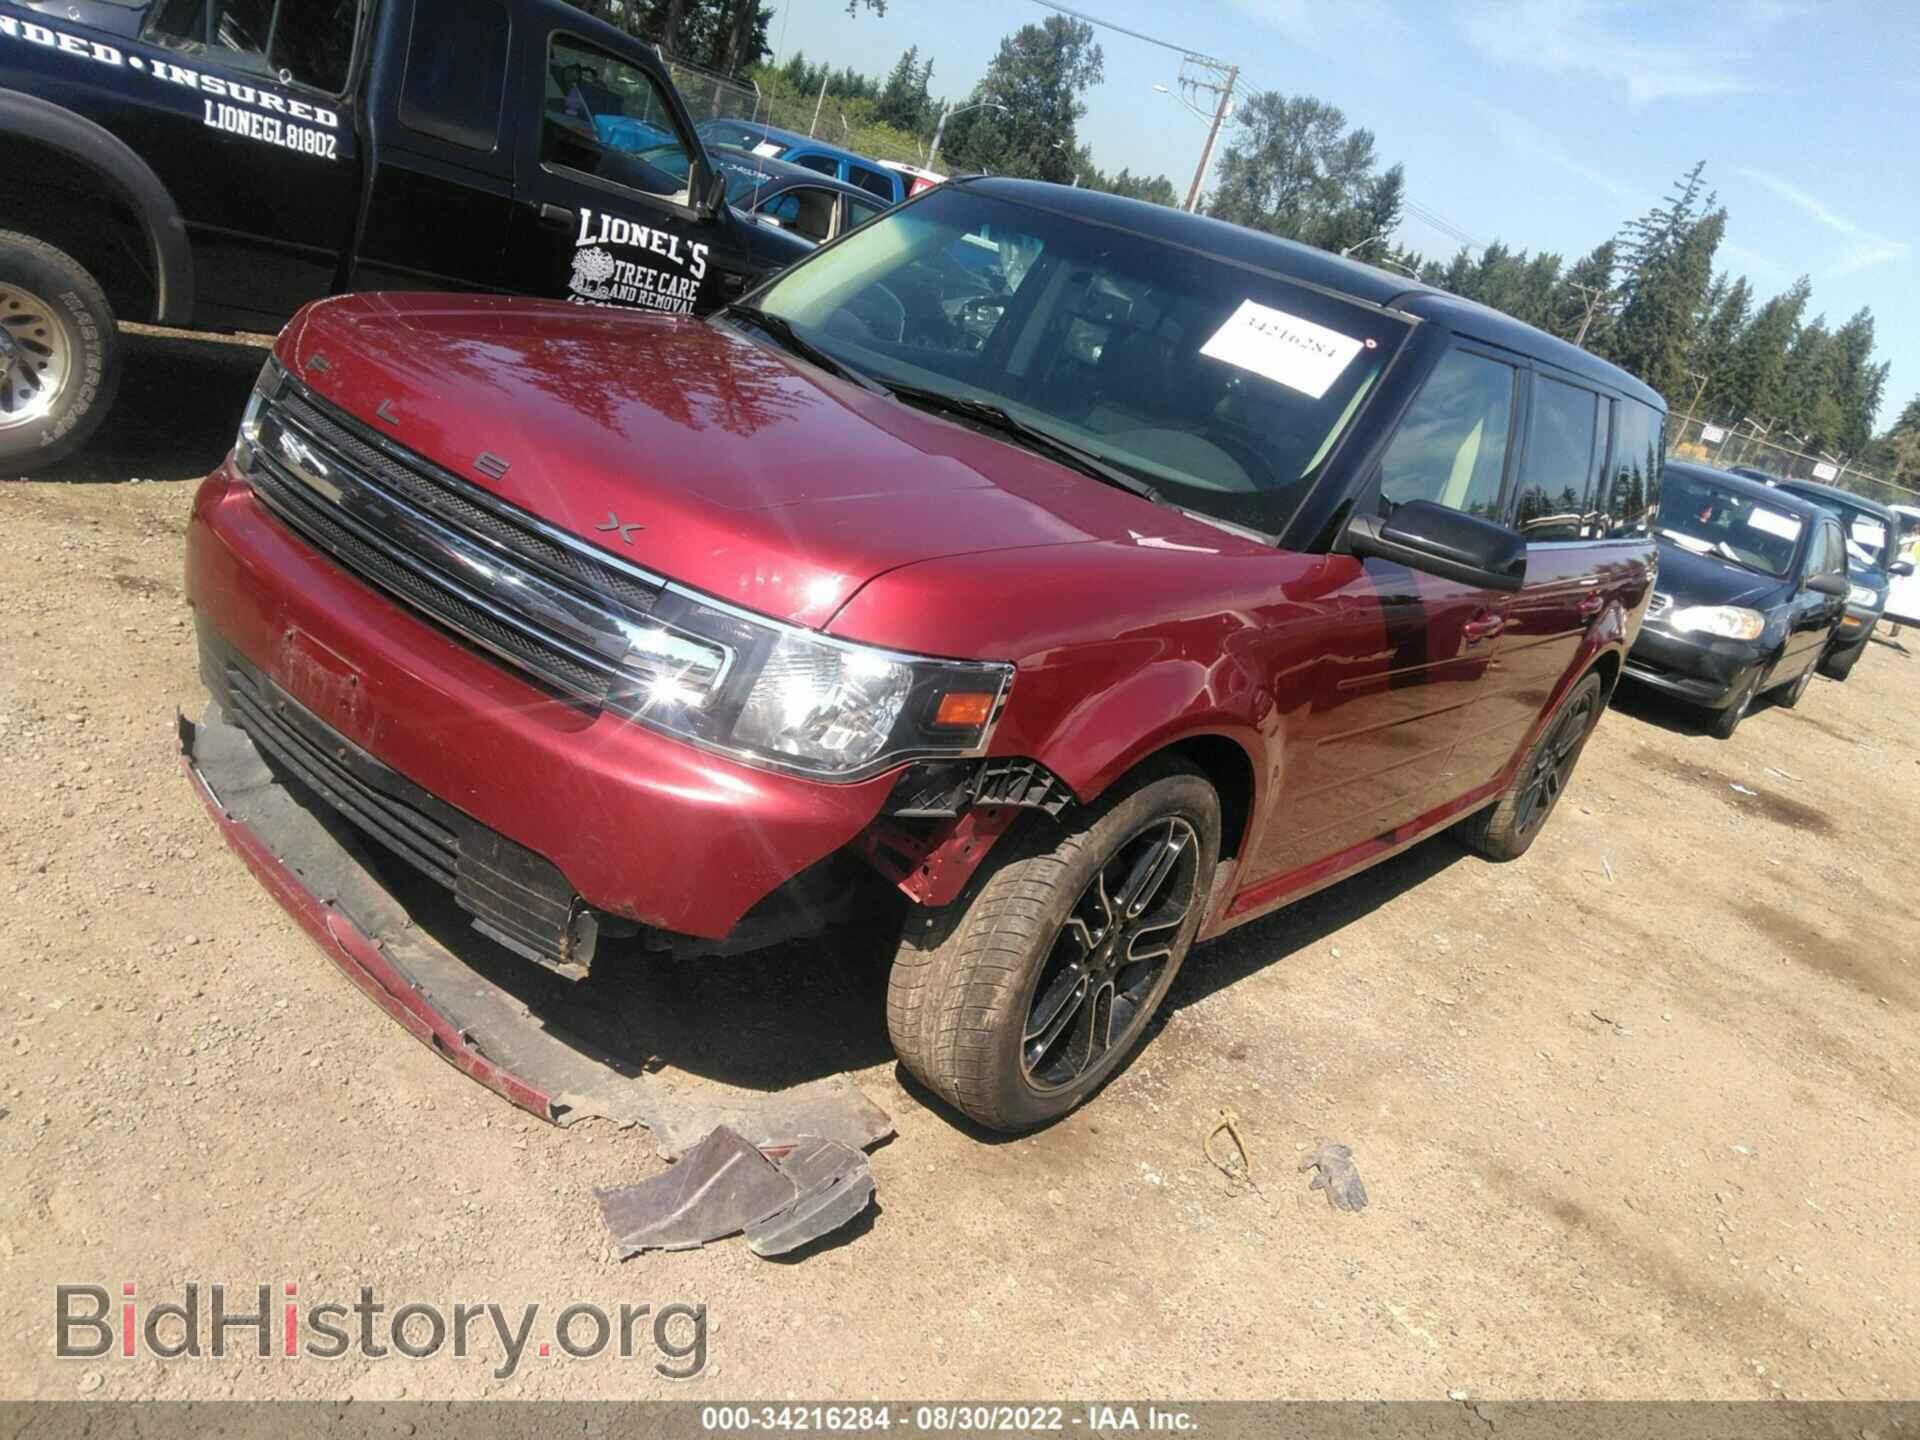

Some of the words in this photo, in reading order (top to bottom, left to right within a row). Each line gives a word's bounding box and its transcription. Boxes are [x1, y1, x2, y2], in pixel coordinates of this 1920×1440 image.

[203, 99, 337, 159] LIONEGL81802
[576, 207, 709, 280] LIONEL'S
[609, 283, 636, 302] AND
[638, 289, 695, 316] REMOVAL
[613, 259, 658, 291] TREE
[658, 272, 700, 301] CARE
